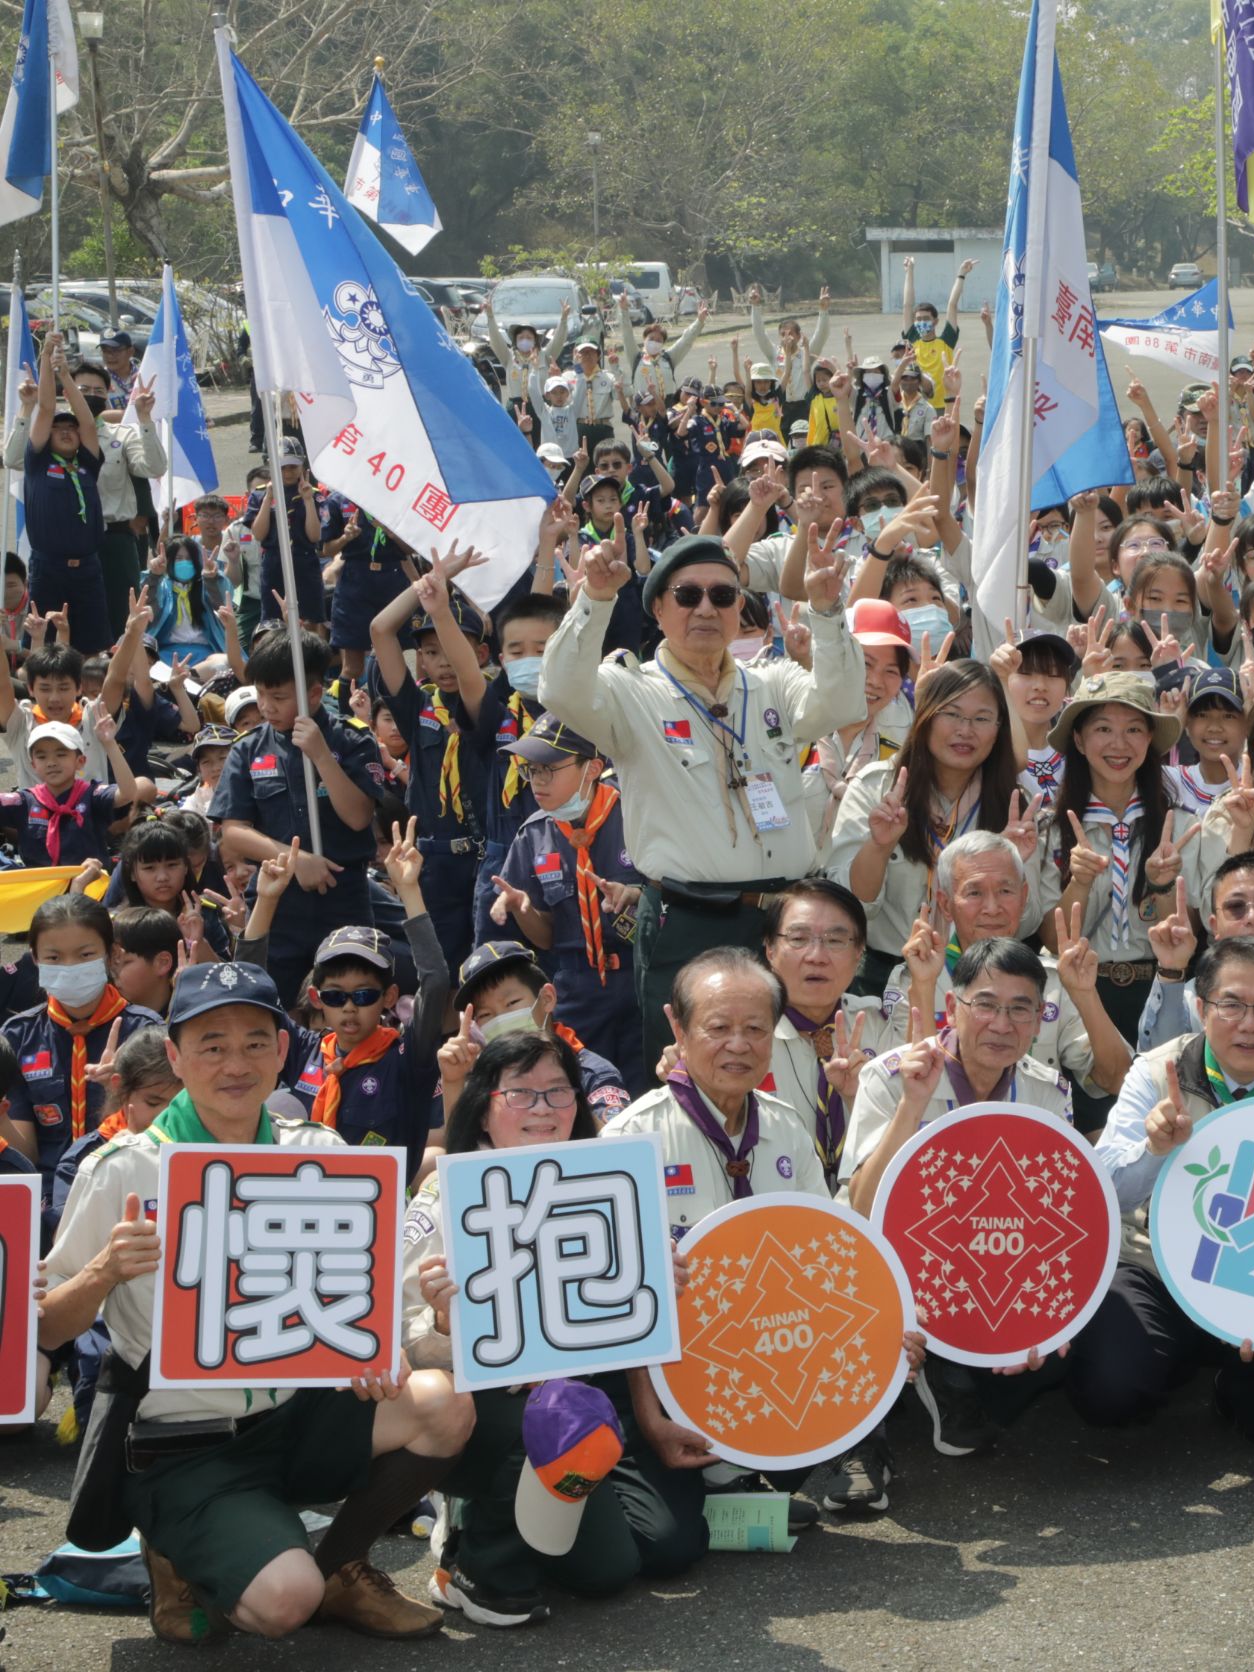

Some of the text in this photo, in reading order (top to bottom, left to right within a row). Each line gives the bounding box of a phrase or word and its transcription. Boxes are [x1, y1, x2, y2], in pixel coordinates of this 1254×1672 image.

[969, 1216, 1025, 1231] TAINAN
[968, 1231, 1025, 1257] 400
[174, 1159, 381, 1368] 懷
[462, 1159, 658, 1368] 抱
[749, 1308, 811, 1333] TAINAN
[754, 1325, 814, 1358] 400
